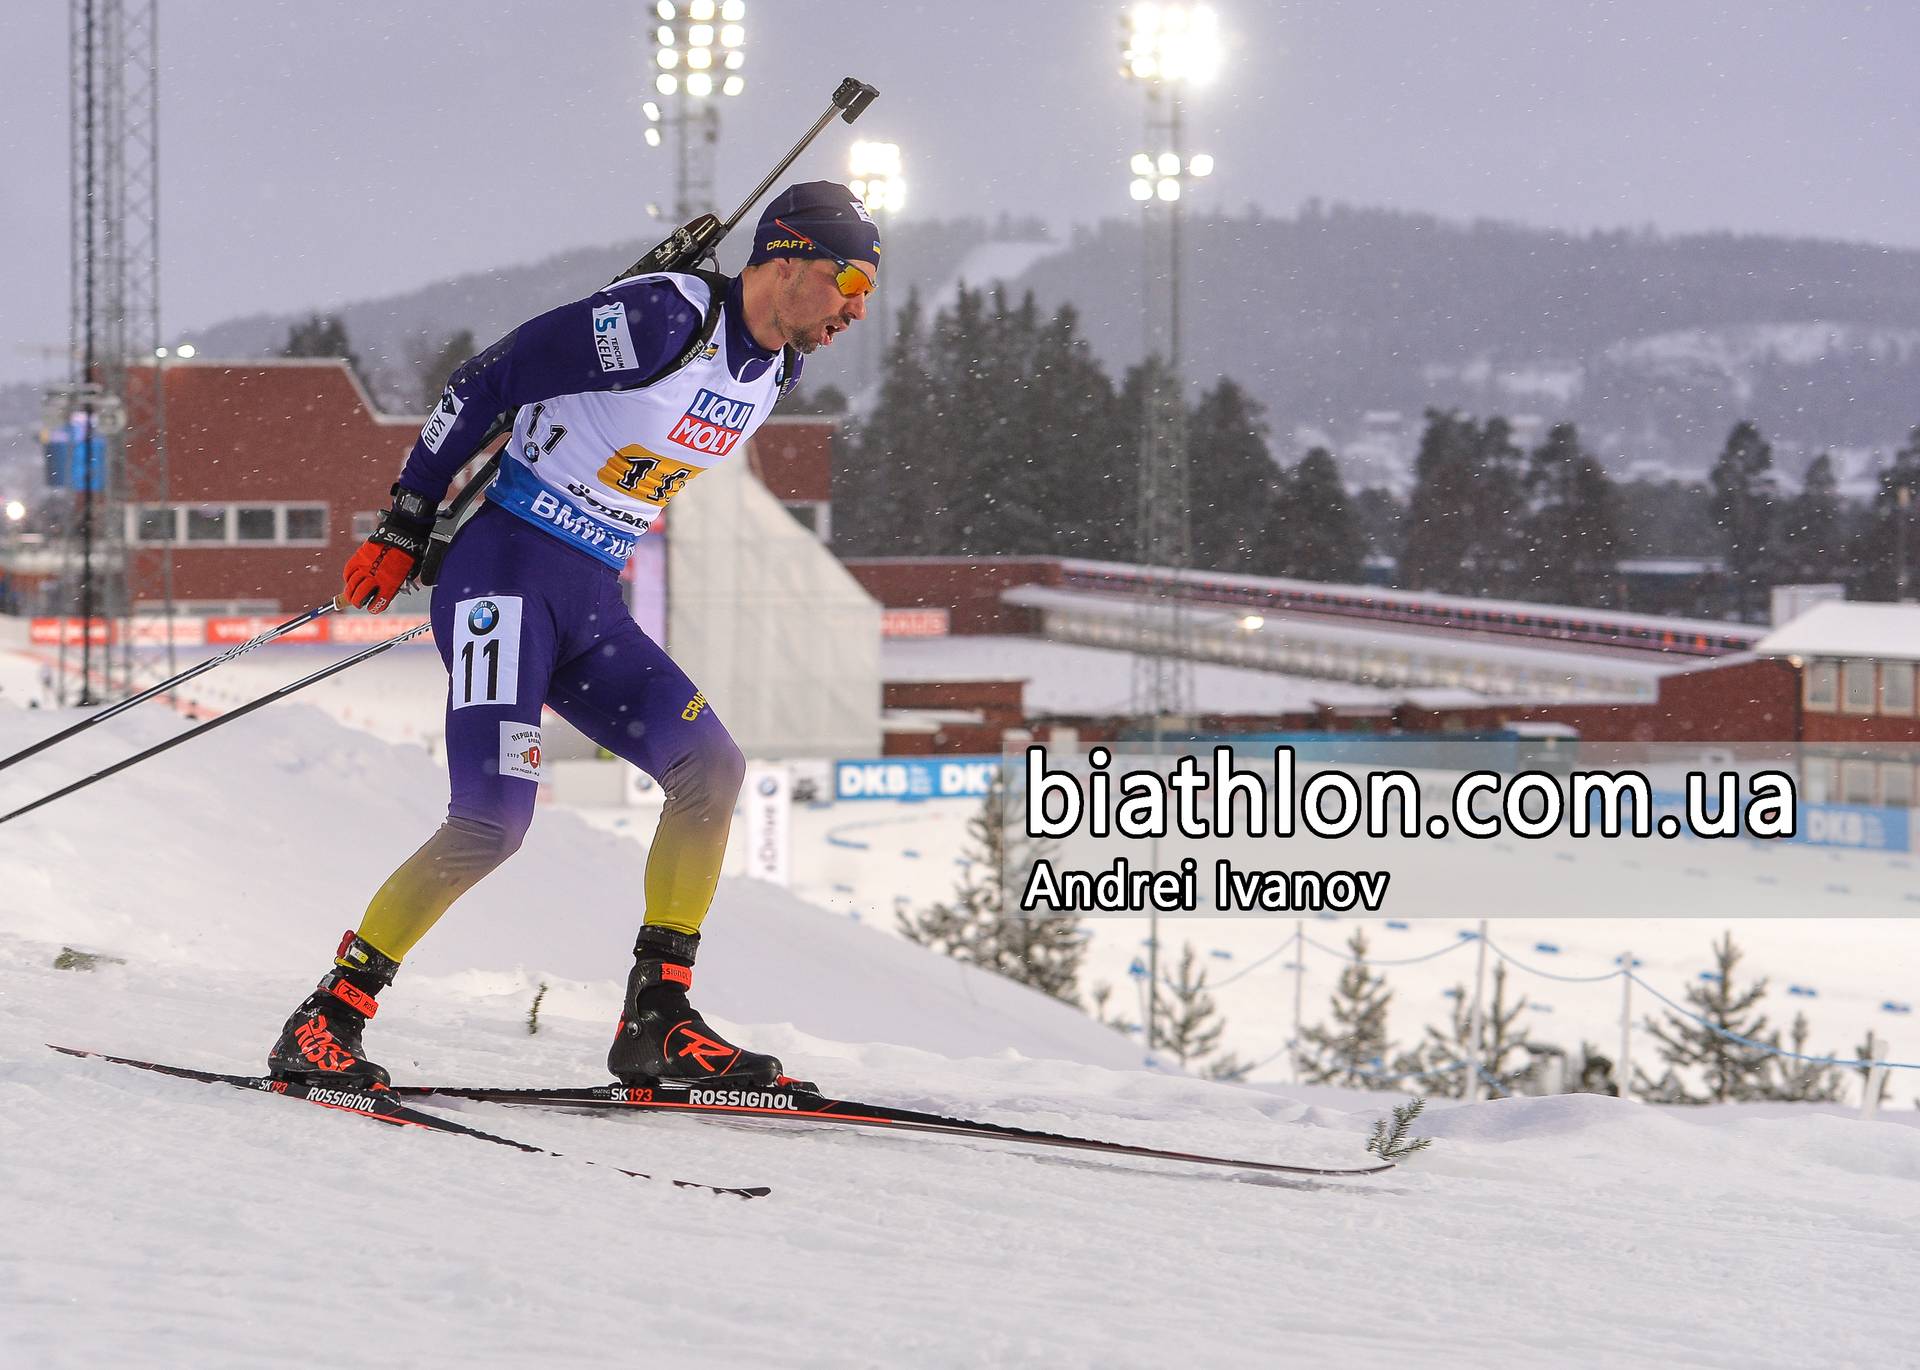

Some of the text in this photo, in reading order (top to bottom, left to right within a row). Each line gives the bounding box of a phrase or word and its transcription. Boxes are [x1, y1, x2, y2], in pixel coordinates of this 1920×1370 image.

[766, 239, 807, 251] CRAFT
[595, 335, 615, 371] KELA
[611, 337, 625, 369] TERCIUM
[690, 391, 752, 429] LIQUI
[672, 417, 739, 454] MOLY
[461, 639, 500, 703] 11
[840, 765, 909, 797] DKB
[258, 1079, 289, 1095] SK193
[611, 1088, 653, 1102] SK193
